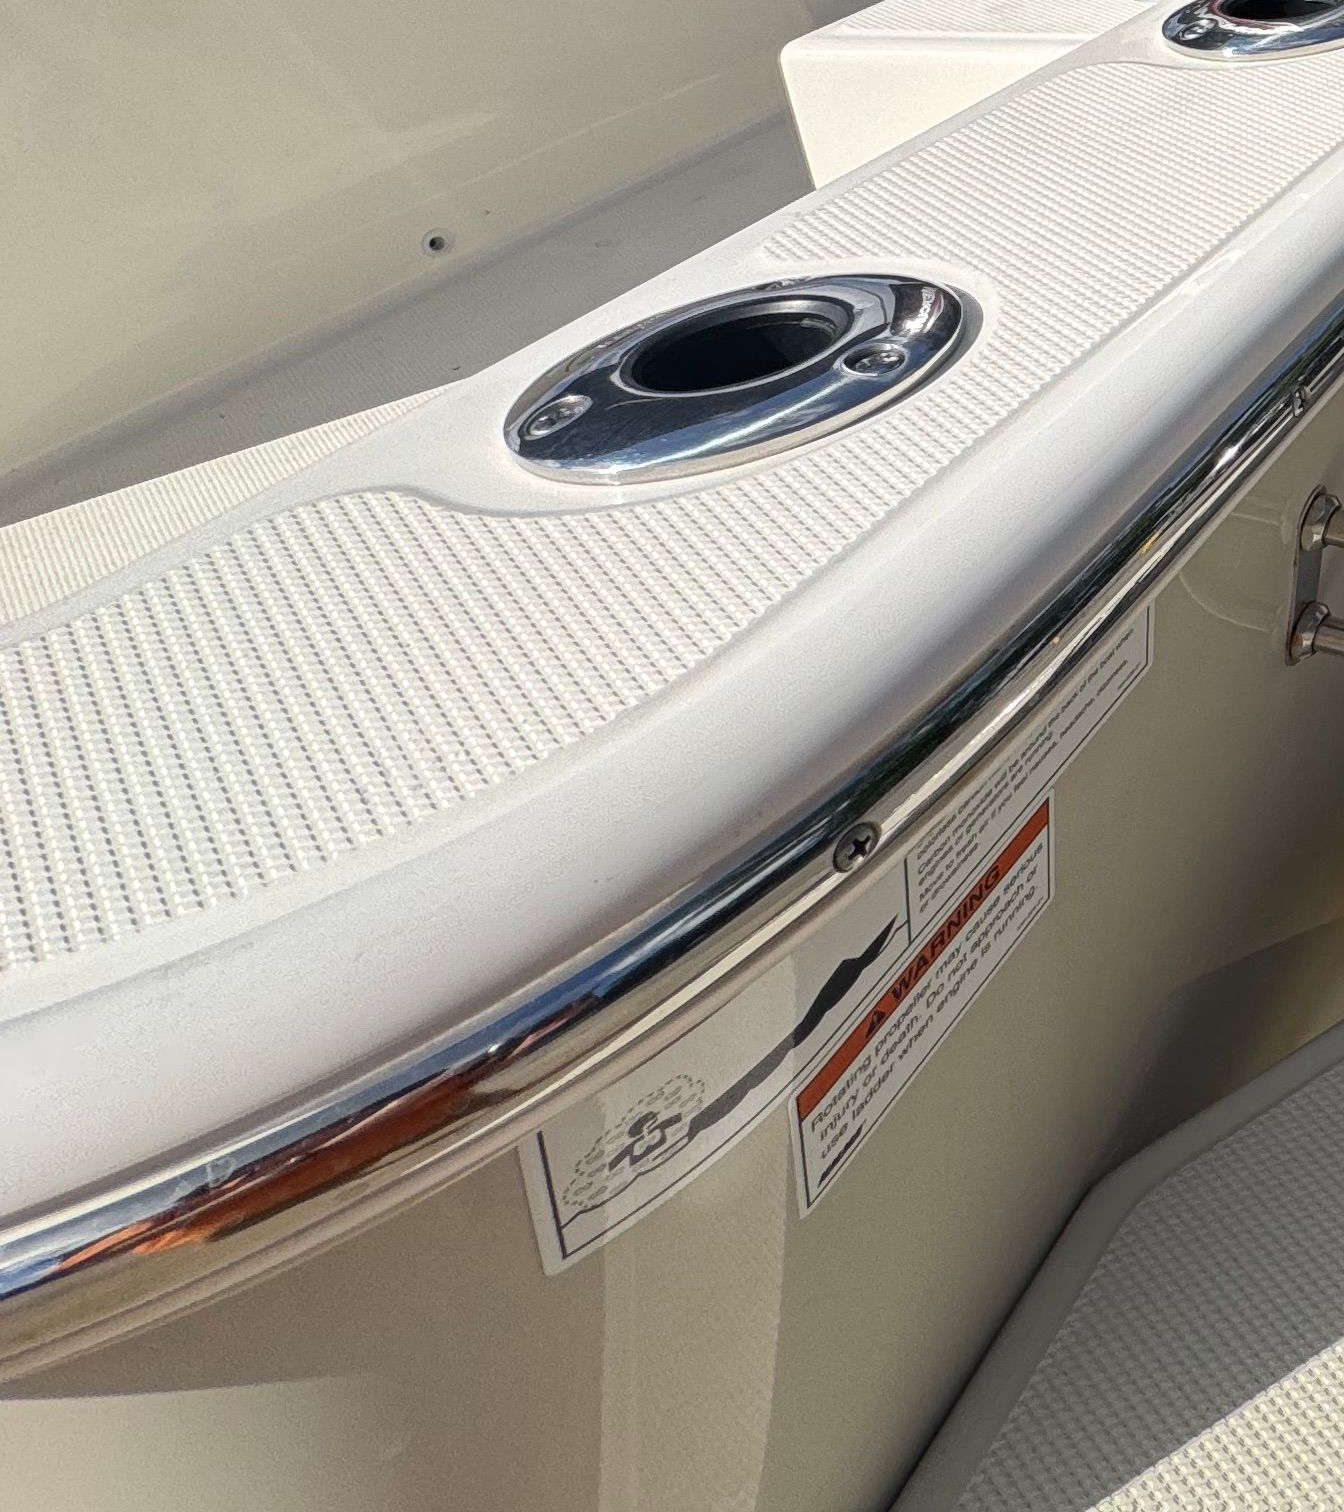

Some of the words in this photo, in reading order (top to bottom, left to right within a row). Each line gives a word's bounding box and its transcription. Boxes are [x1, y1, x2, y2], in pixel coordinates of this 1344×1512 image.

[810, 1053, 871, 1133] Rotating
[874, 977, 932, 1055] propeller
[935, 942, 962, 979] may
[965, 895, 1000, 941] cause
[1002, 841, 1042, 895] serious
[818, 1087, 859, 1143] injury
[861, 1063, 877, 1089] or
[925, 978, 944, 1010] Do
[947, 949, 967, 982] not
[969, 881, 1024, 954] approach
[1026, 863, 1037, 884] or
[820, 1121, 848, 1158] use
[851, 1062, 894, 1119] ladder
[897, 1013, 933, 1061] when
[936, 956, 978, 1014] engine
[980, 938, 990, 958] is
[890, 864, 1000, 1004] WARNING
